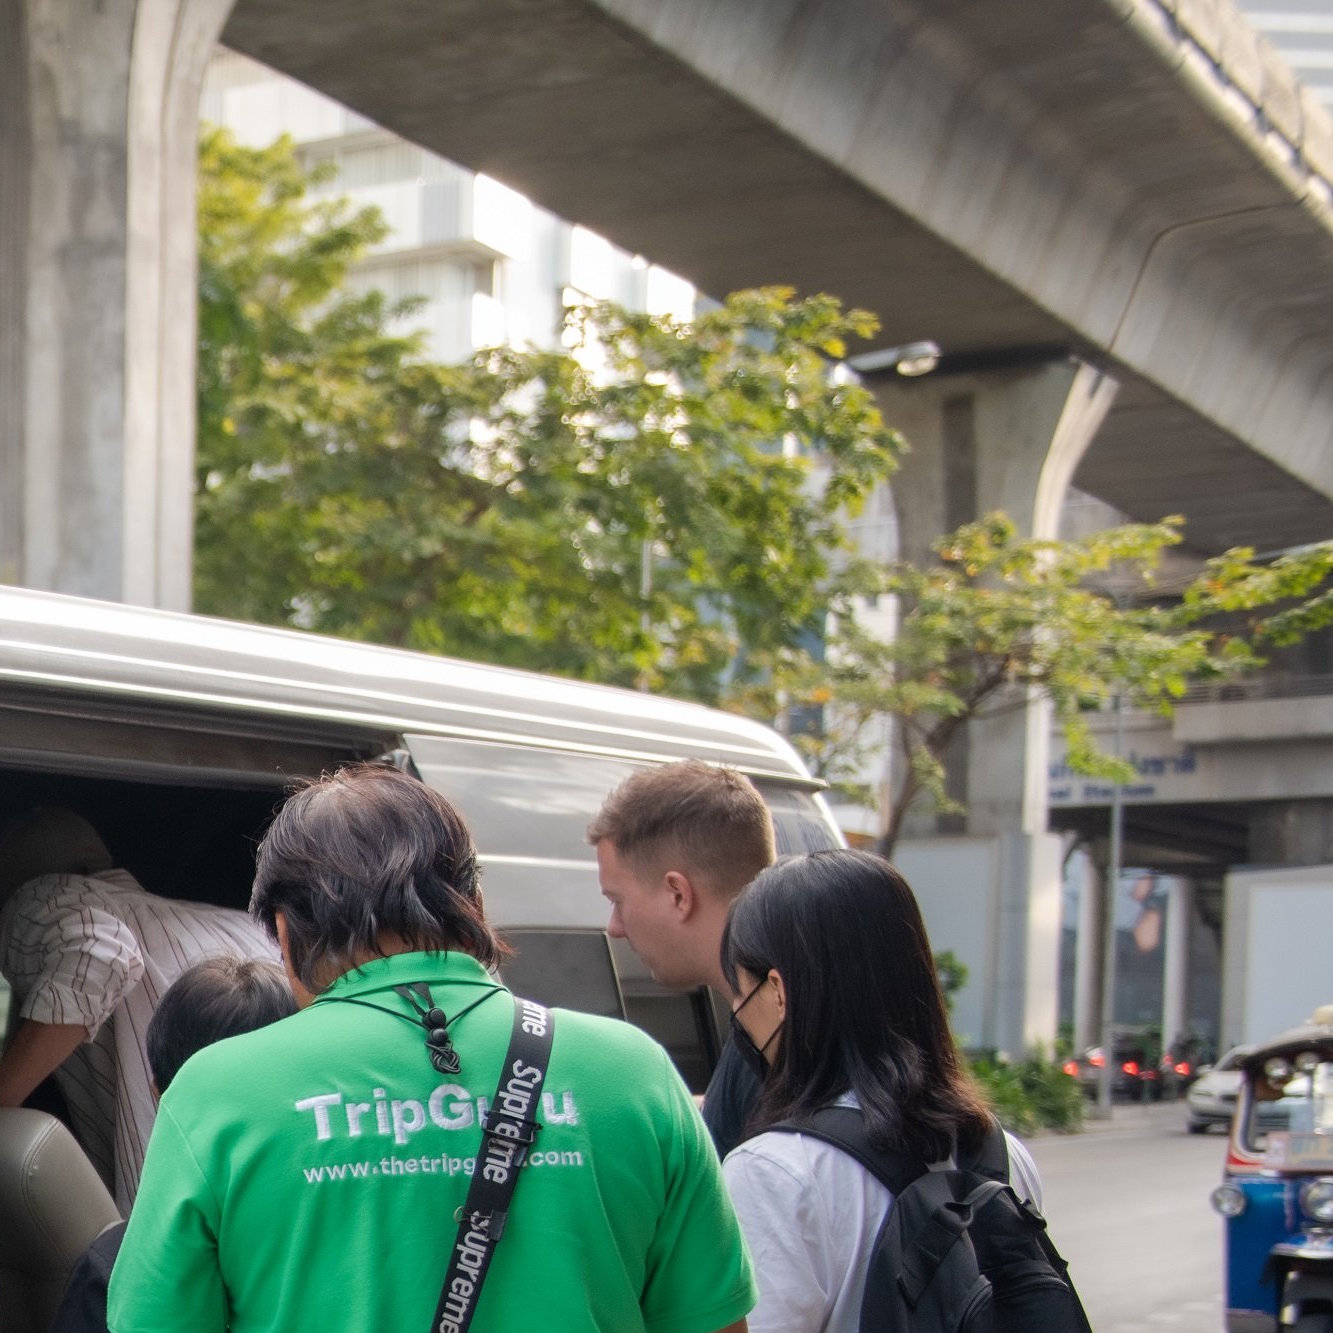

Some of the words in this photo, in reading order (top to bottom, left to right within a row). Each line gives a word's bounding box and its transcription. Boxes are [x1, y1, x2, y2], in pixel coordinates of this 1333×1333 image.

[295, 1084, 580, 1144] TripGu
[483, 1059, 542, 1184] Supreme
[303, 1149, 583, 1184] www.thetripg.com
